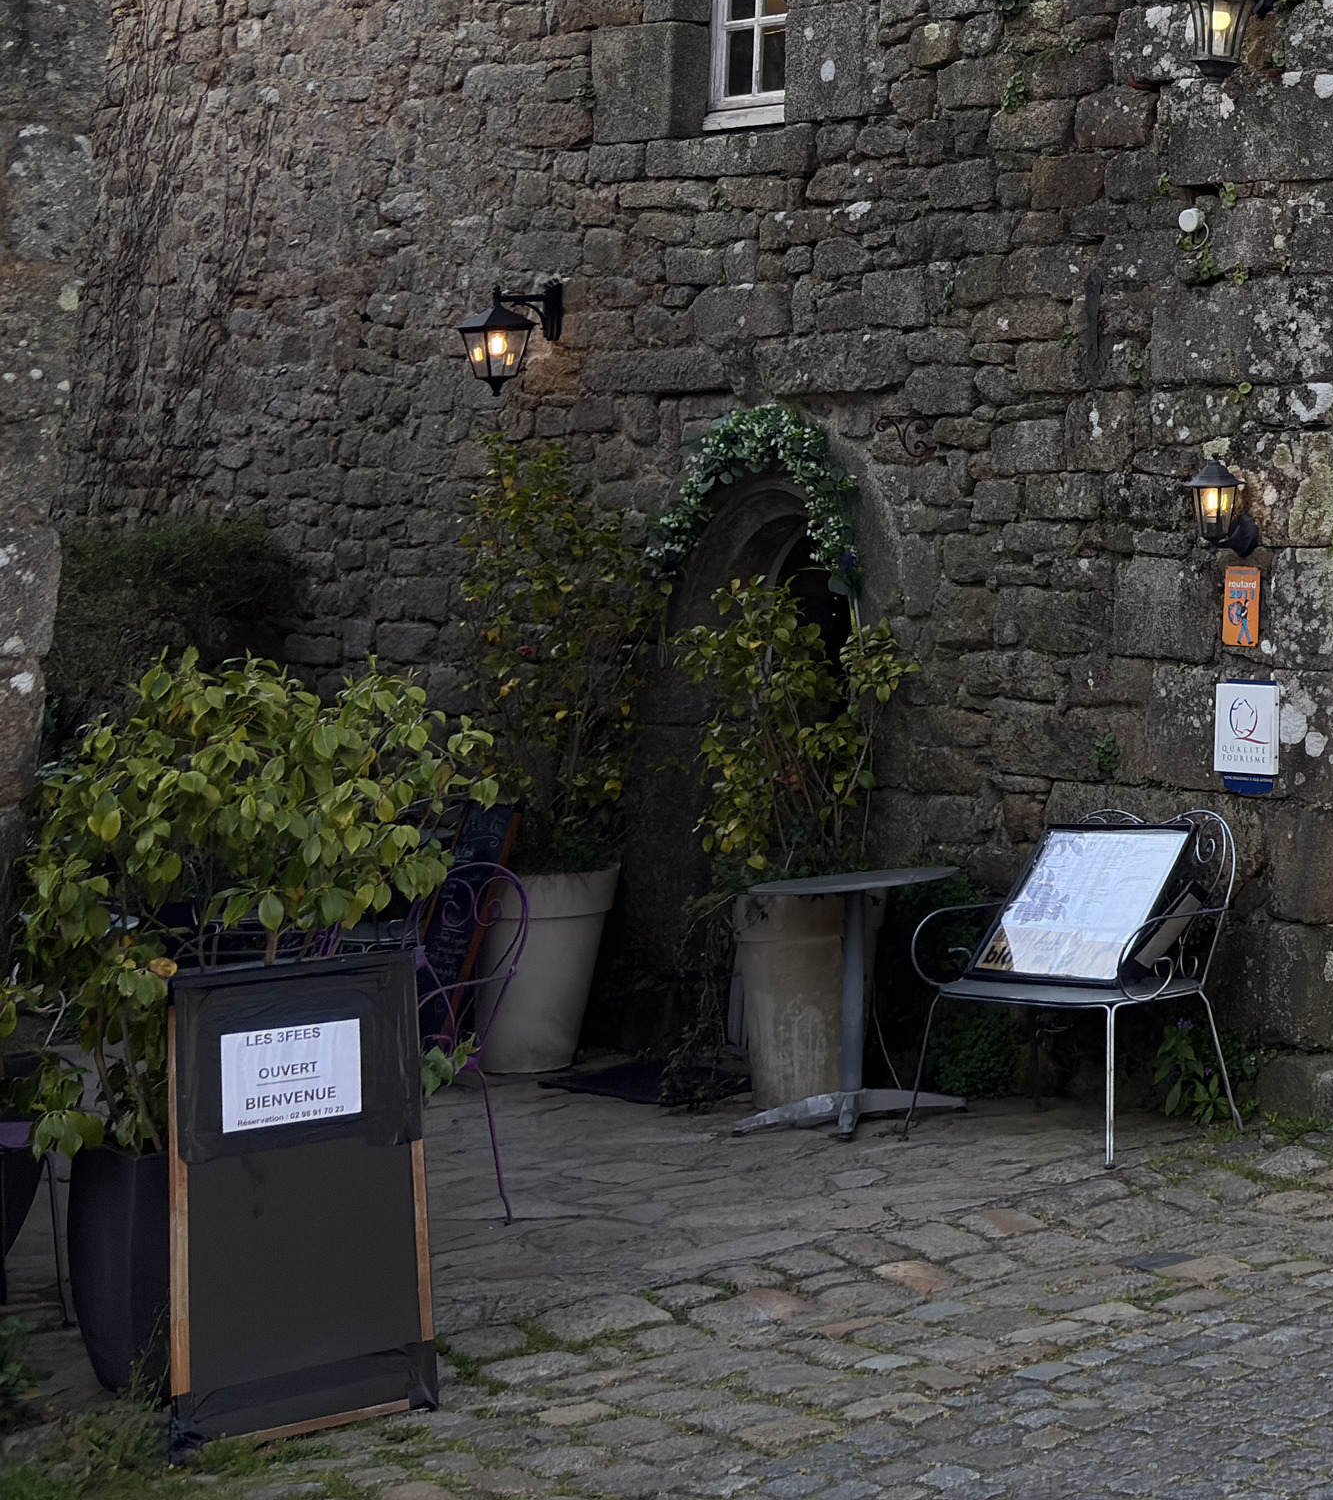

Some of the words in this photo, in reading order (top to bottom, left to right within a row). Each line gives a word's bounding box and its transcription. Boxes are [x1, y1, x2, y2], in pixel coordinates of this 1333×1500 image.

[1228, 580, 1257, 589] routard
[1229, 589, 1255, 600] 2011
[1221, 745, 1266, 755] QUALITÉ
[1222, 754, 1266, 763] TOURISME
[246, 1032, 273, 1047] LES
[277, 1027, 321, 1043] 3FEES
[258, 1061, 318, 1080] OUVERT
[245, 1086, 337, 1111] BIENVENUE
[237, 1113, 284, 1127] Réservation
[290, 1111, 300, 1119] 02
[313, 1108, 322, 1116] 91
[335, 1105, 344, 1113] 23
